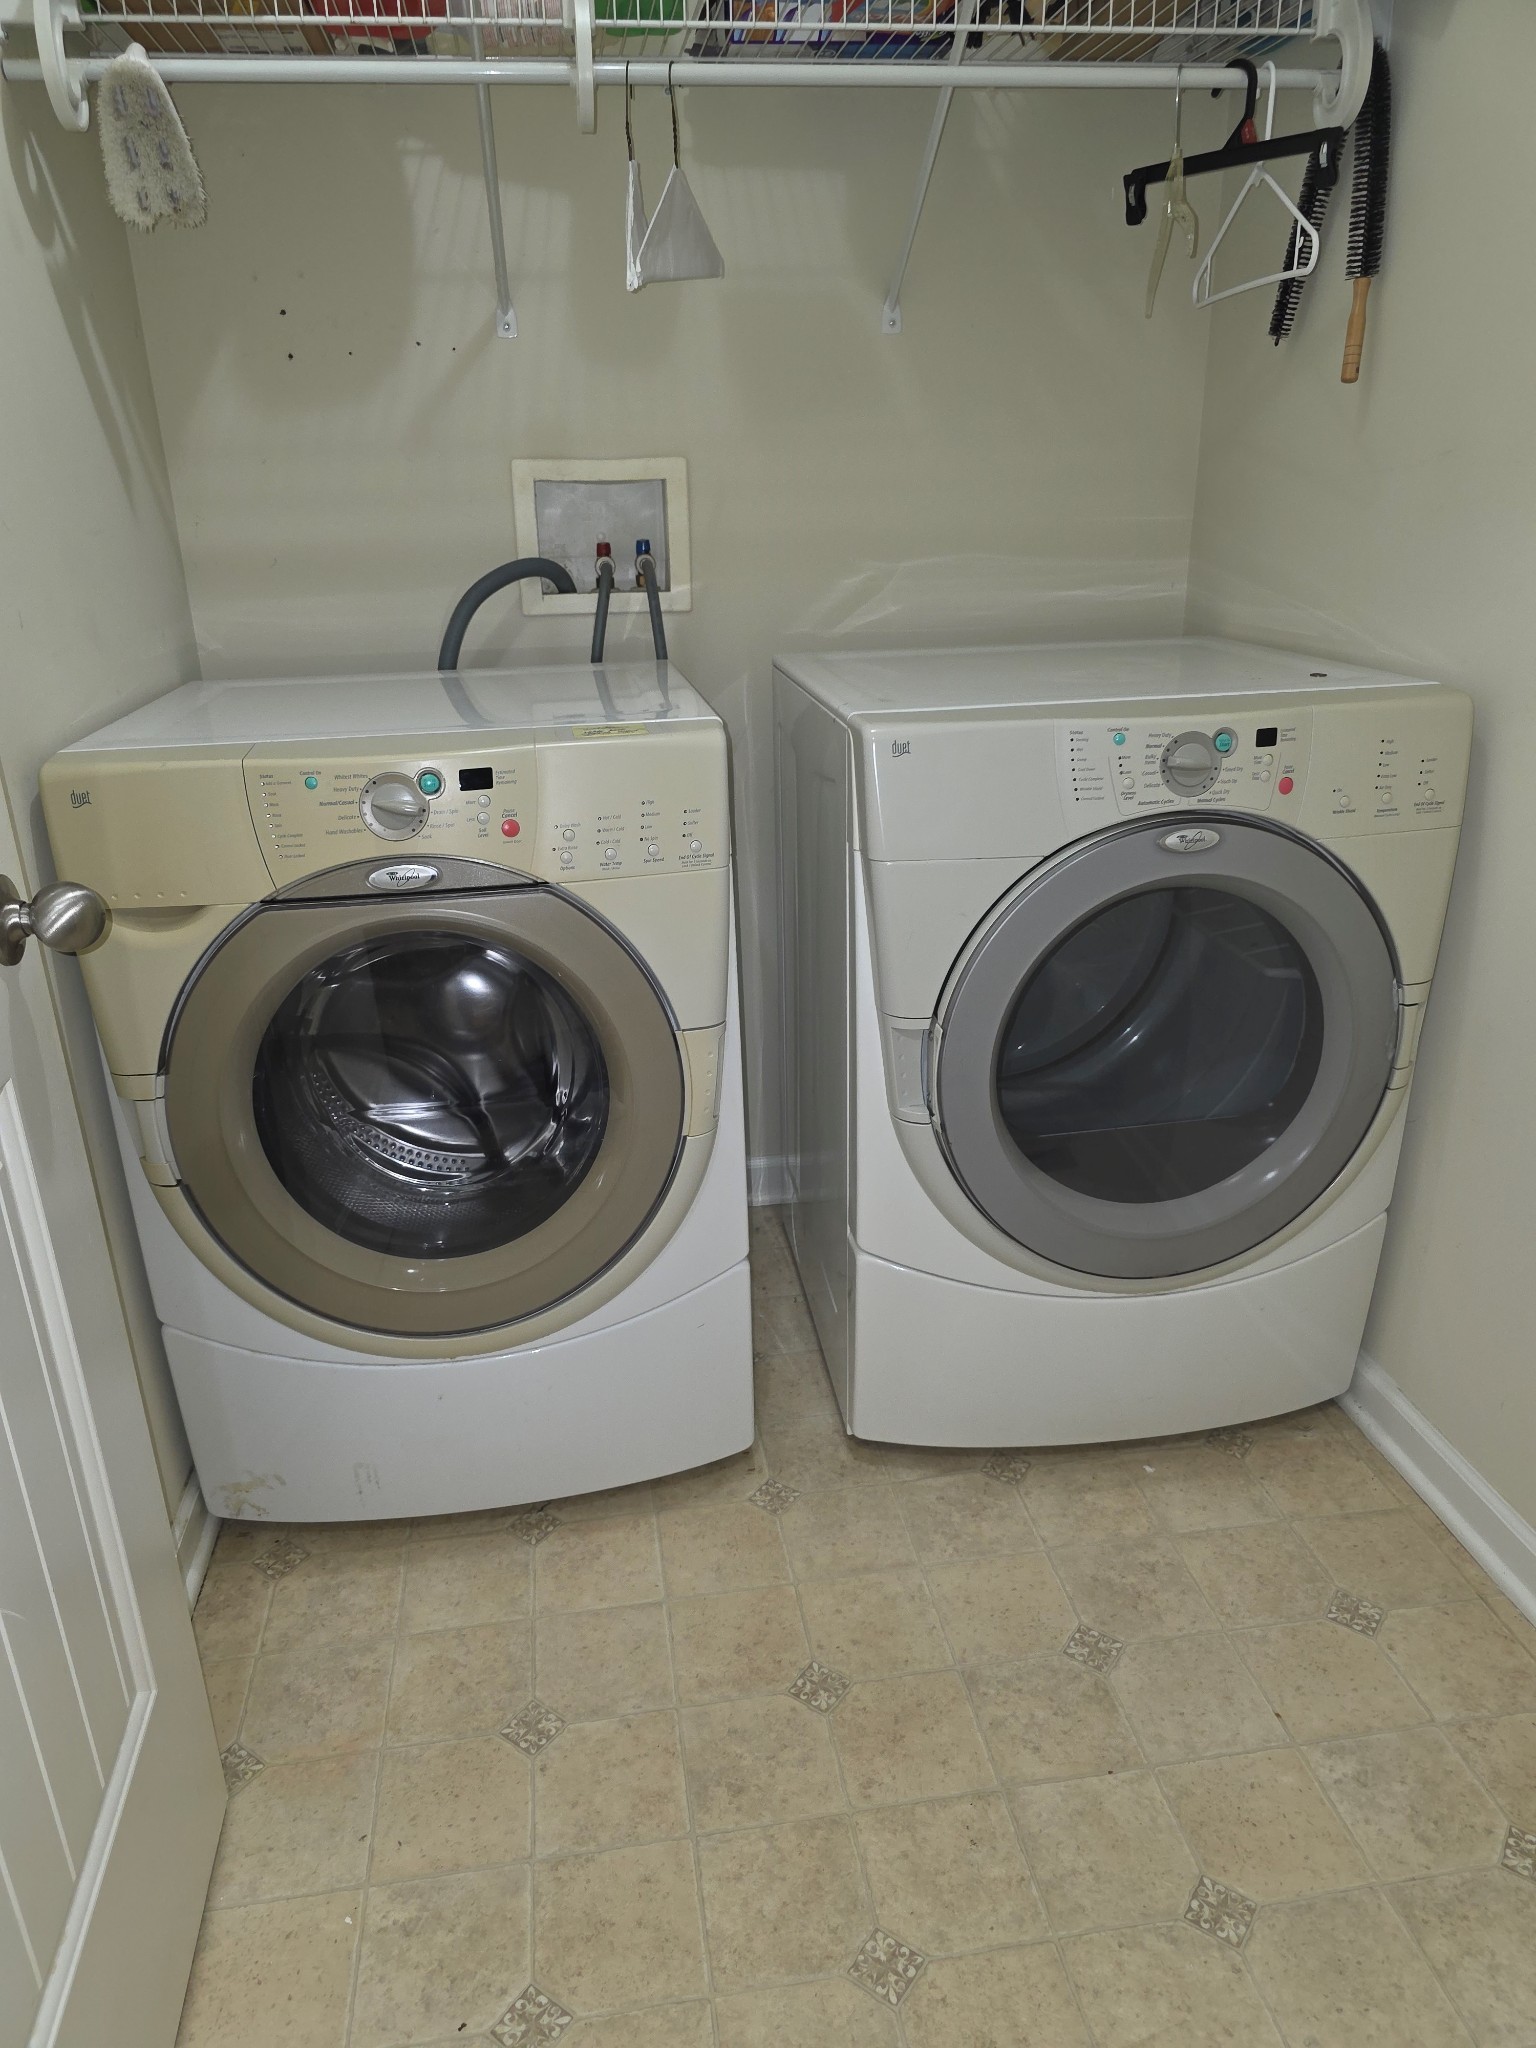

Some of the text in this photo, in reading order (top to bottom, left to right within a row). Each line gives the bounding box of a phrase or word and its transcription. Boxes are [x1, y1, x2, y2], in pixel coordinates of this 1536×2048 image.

[892, 740, 912, 757] duet
[70, 789, 92, 808] duet
[501, 811, 518, 819] Cancel
